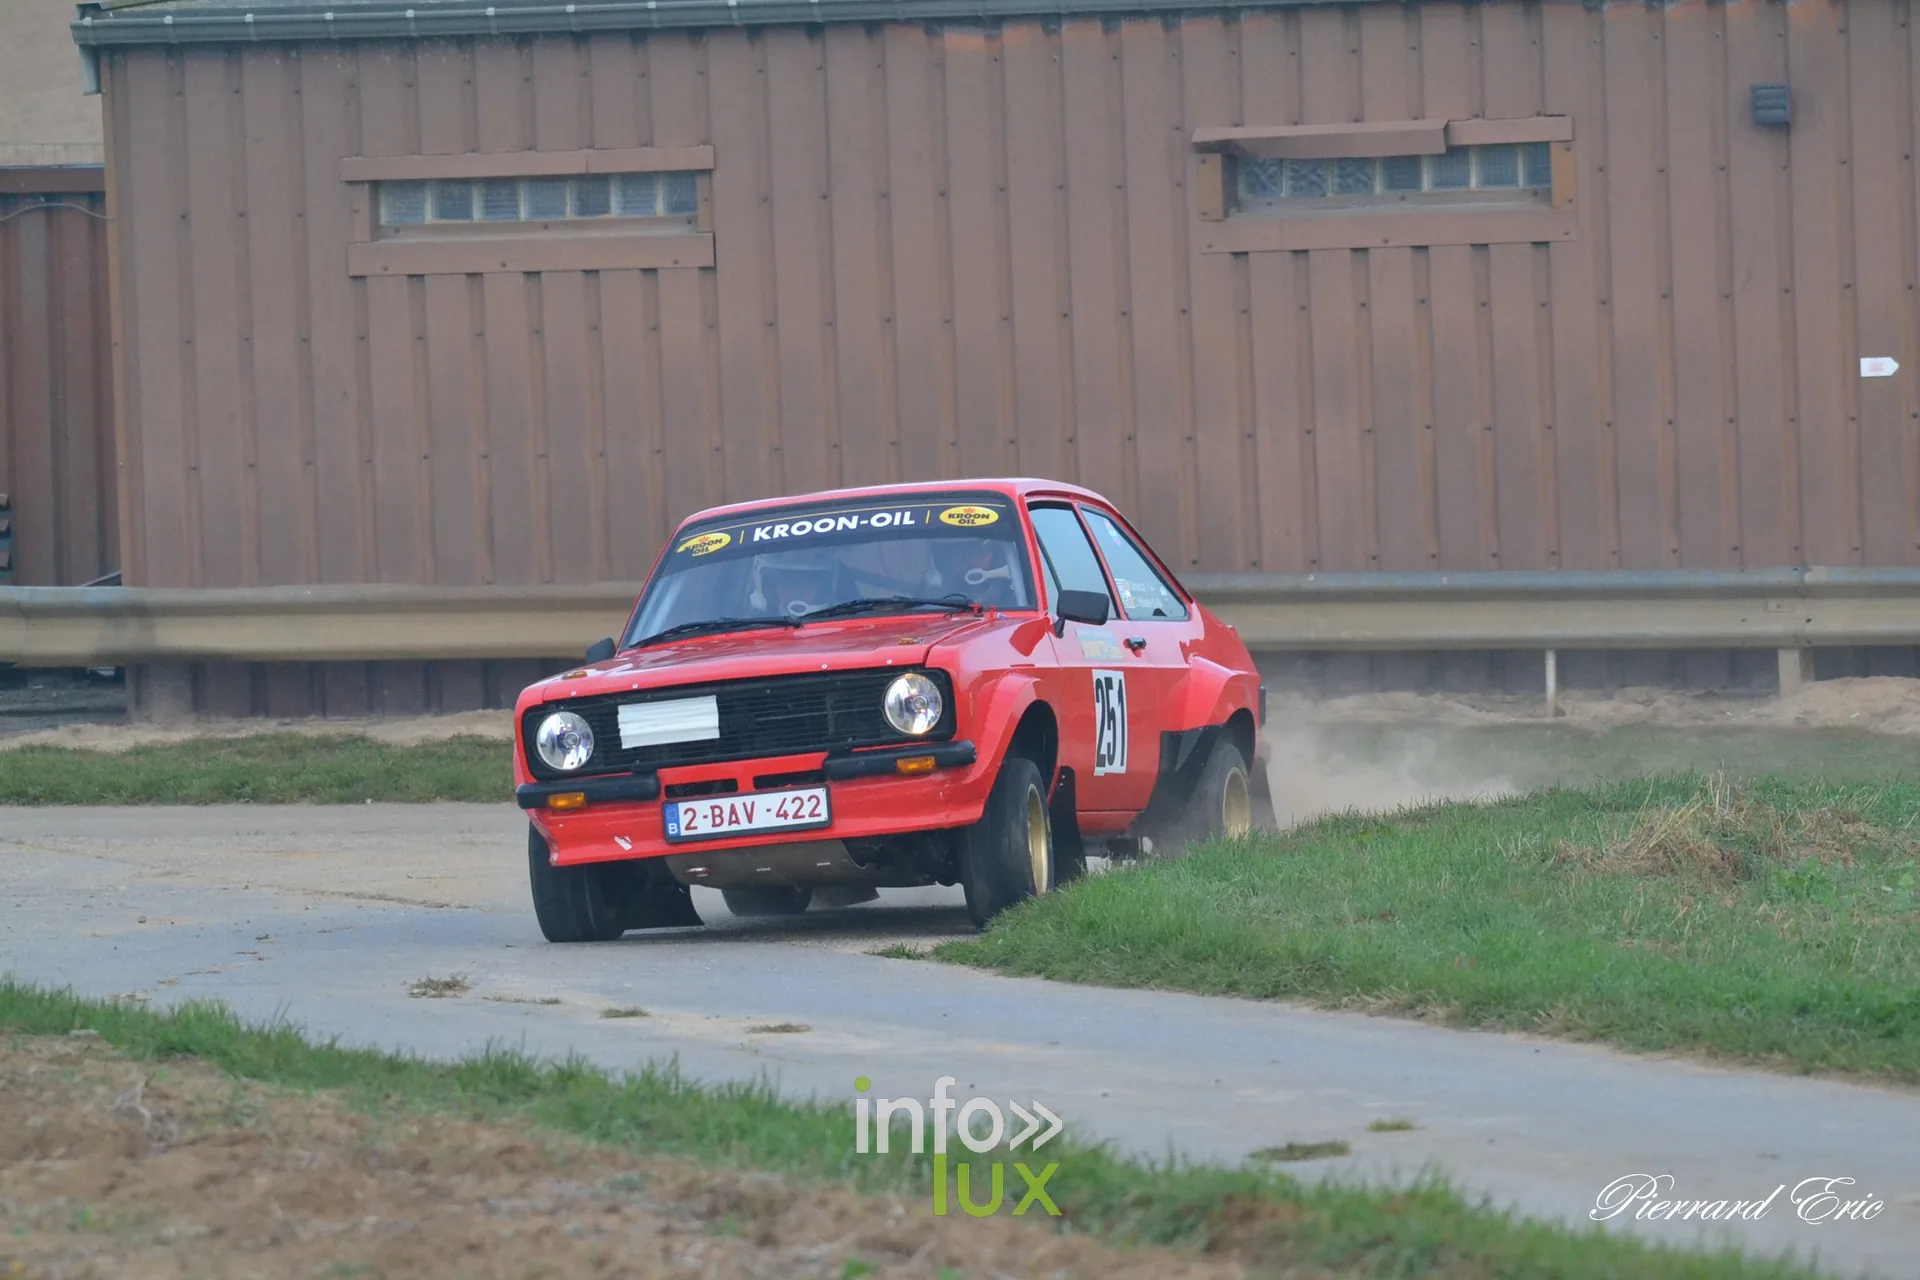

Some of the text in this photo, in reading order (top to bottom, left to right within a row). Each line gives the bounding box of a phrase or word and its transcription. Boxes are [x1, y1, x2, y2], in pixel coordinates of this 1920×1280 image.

[753, 512, 915, 541] KROON-OIL
[693, 547, 710, 555] OIL
[1095, 676, 1126, 768] 251
[668, 823, 678, 834] B
